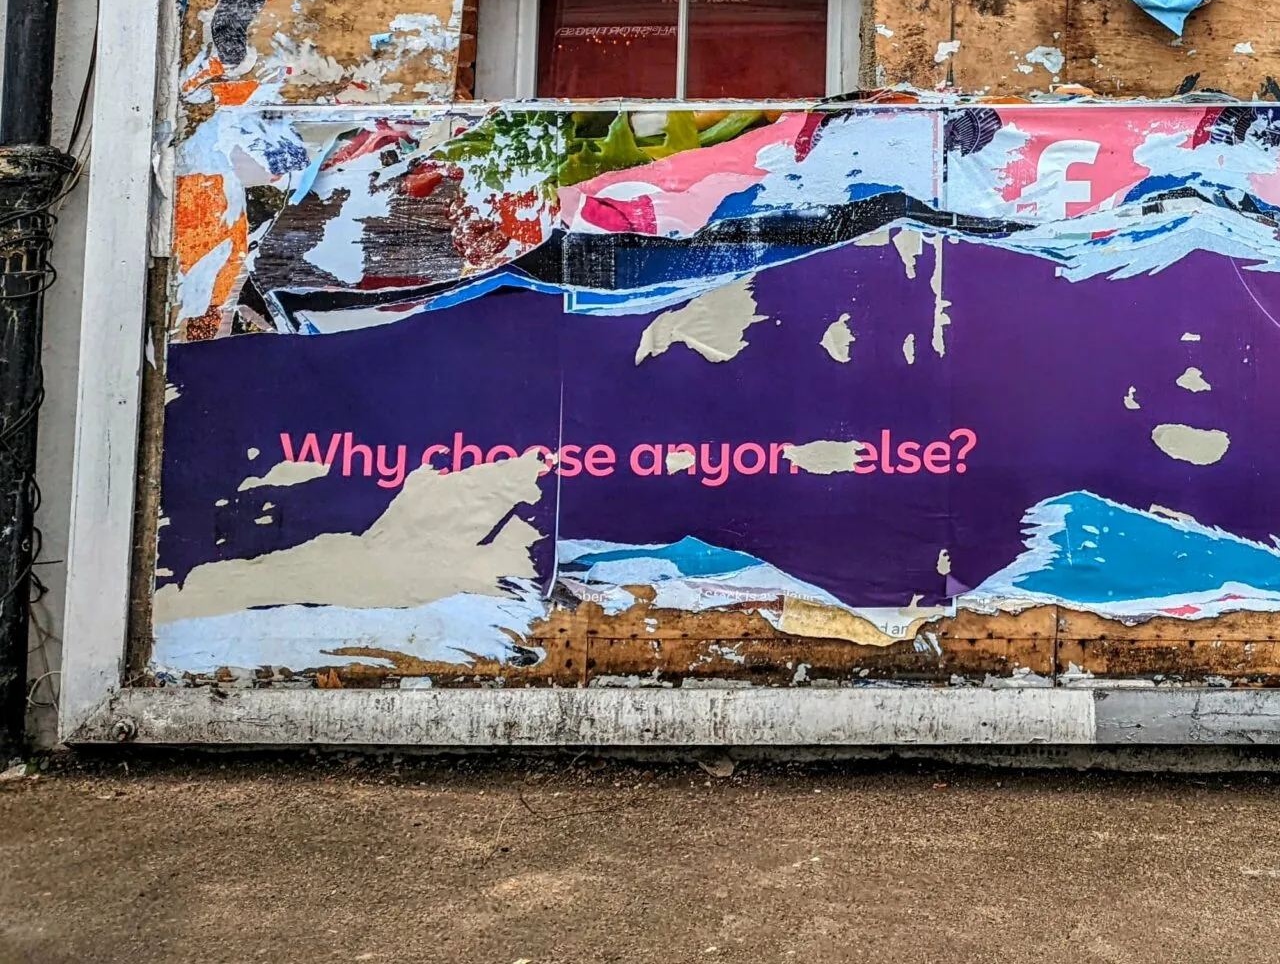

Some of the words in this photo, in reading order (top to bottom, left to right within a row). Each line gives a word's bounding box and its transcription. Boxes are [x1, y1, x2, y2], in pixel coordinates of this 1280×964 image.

[280, 432, 407, 488] Why
[629, 442, 800, 487] anyon
[851, 428, 978, 475] else?
